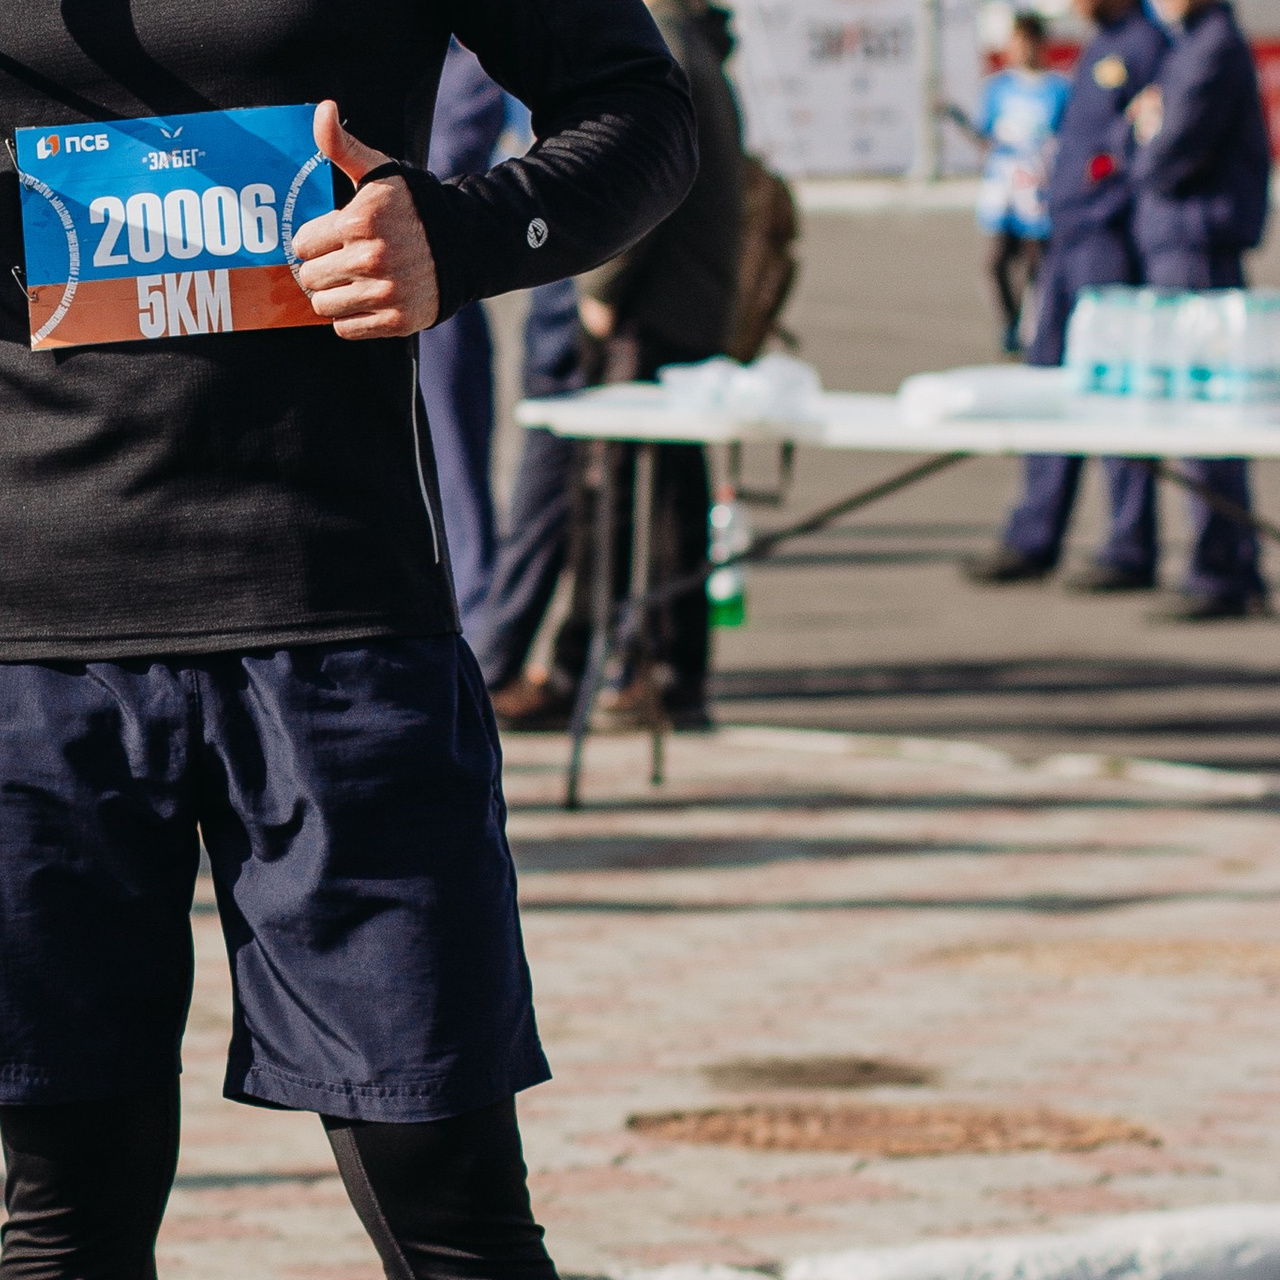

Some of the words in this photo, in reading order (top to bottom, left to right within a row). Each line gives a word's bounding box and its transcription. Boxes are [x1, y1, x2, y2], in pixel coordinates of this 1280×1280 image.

[65, 134, 110, 153] ПСБ
[89, 183, 279, 268] 20006
[136, 269, 233, 339] 5КМ
